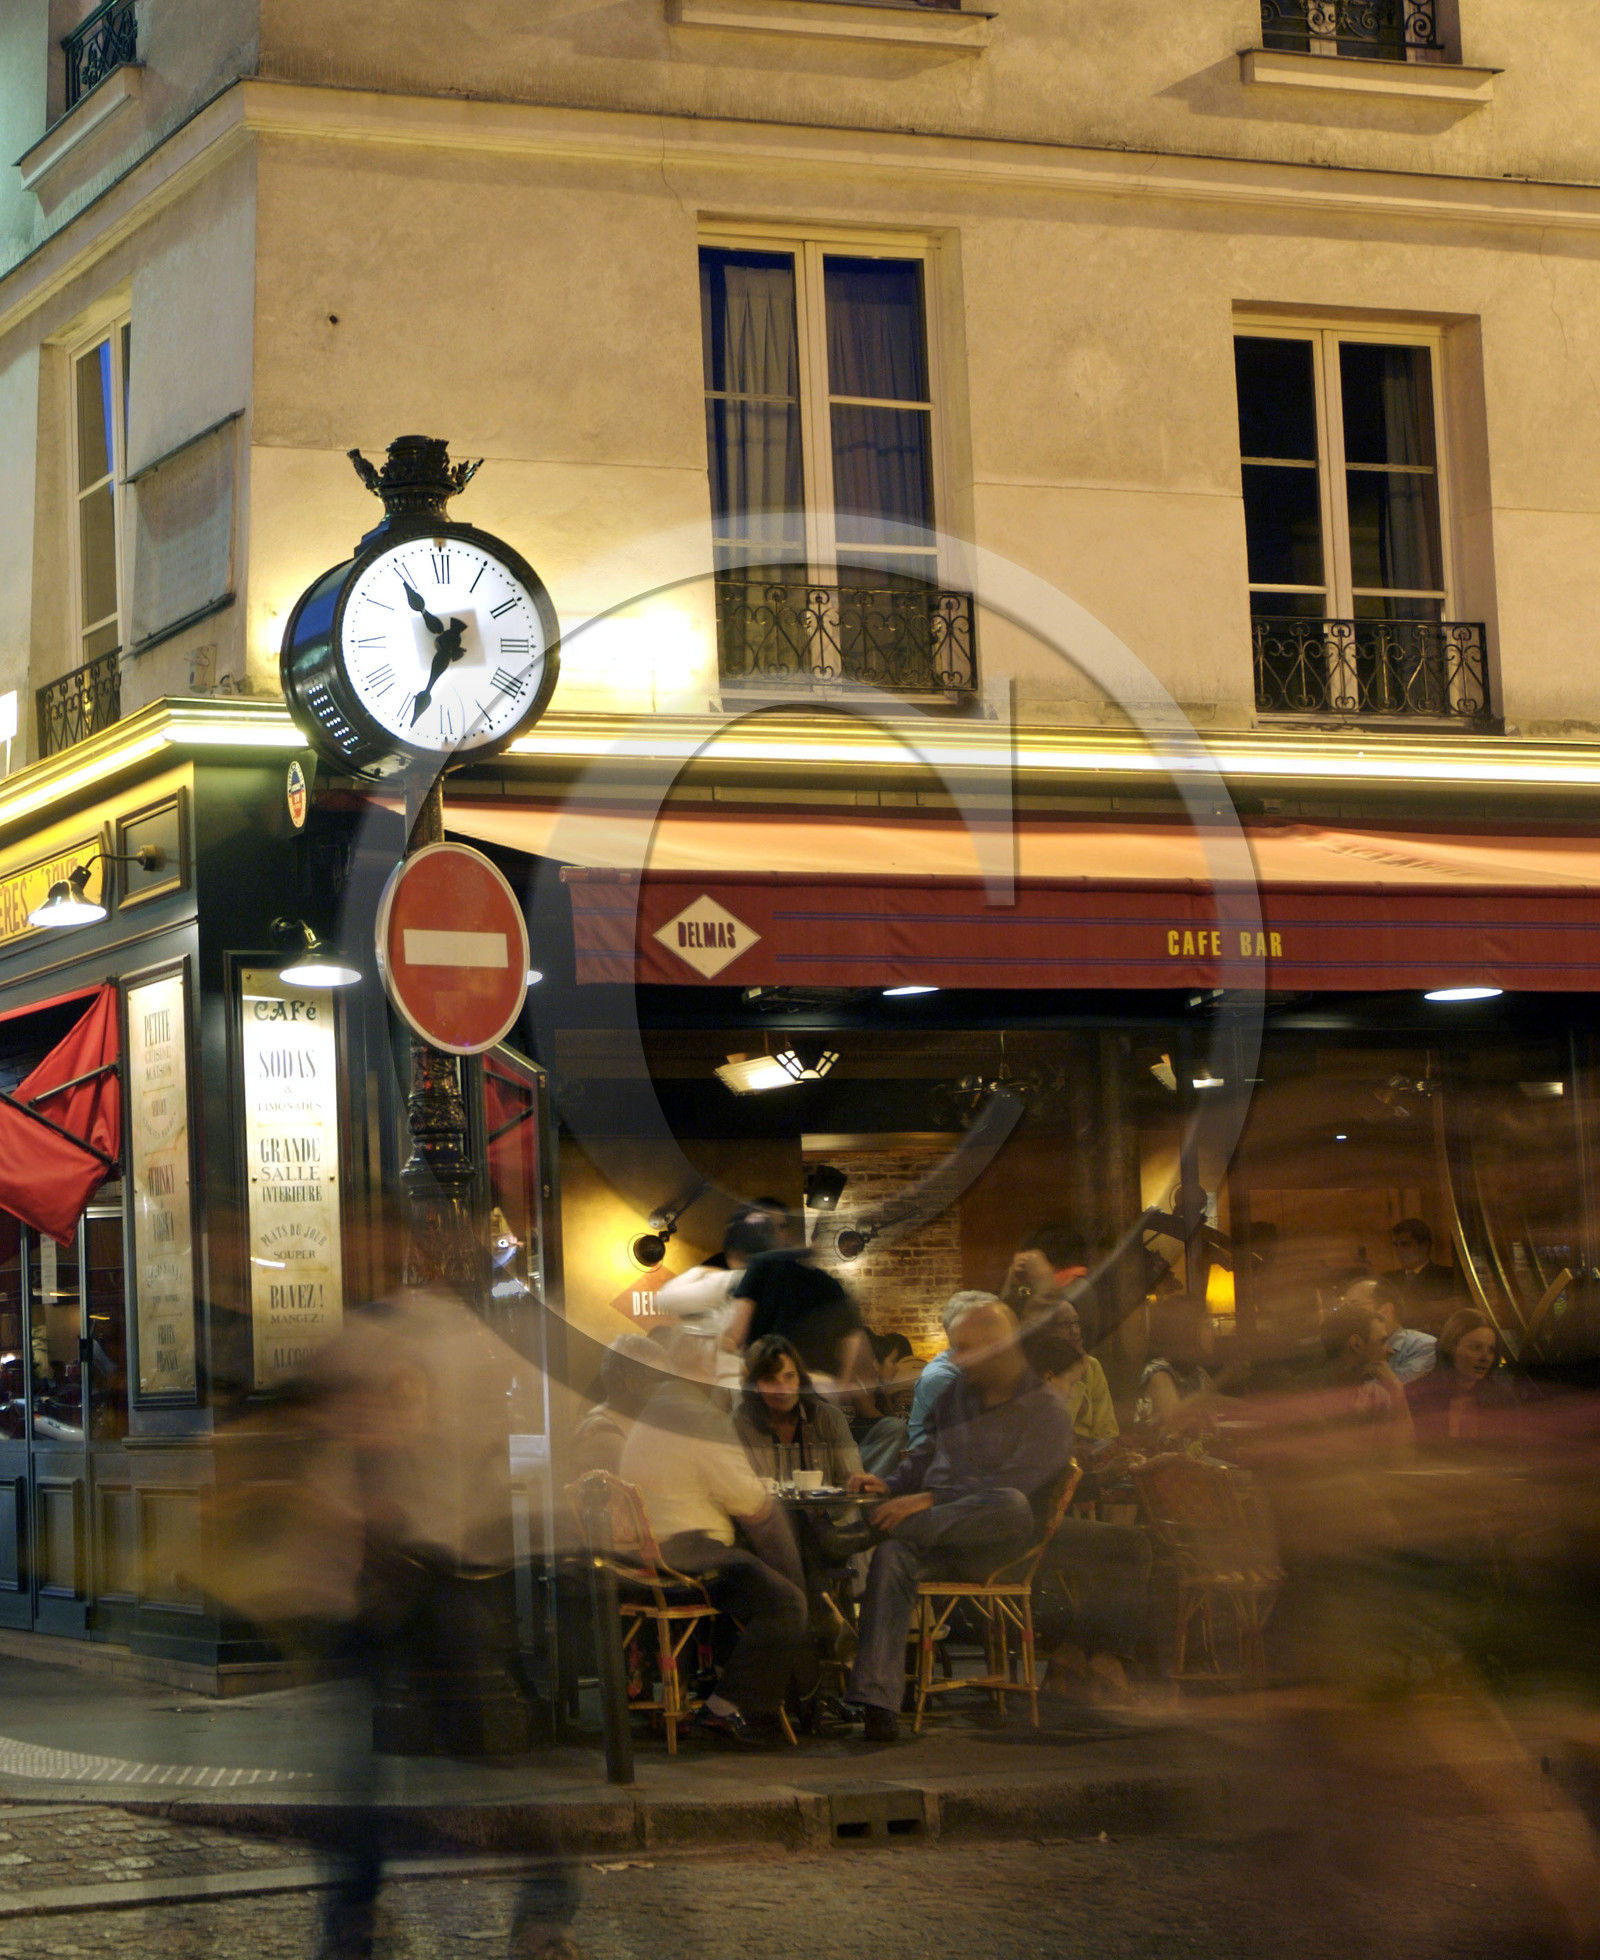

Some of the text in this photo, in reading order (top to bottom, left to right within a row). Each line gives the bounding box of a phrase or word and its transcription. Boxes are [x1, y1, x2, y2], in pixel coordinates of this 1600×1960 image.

[677, 921, 736, 949] DELMAS
[1168, 930, 1283, 957] CAFE BAR
[144, 1008, 171, 1047] PETITE
[259, 1049, 316, 1079] SODAS
[260, 1138, 320, 1163] GRANDE
[261, 1166, 321, 1181] SALLE
[260, 1223, 327, 1247] PLATS DU JOUR
[273, 1250, 316, 1260] SOUPER
